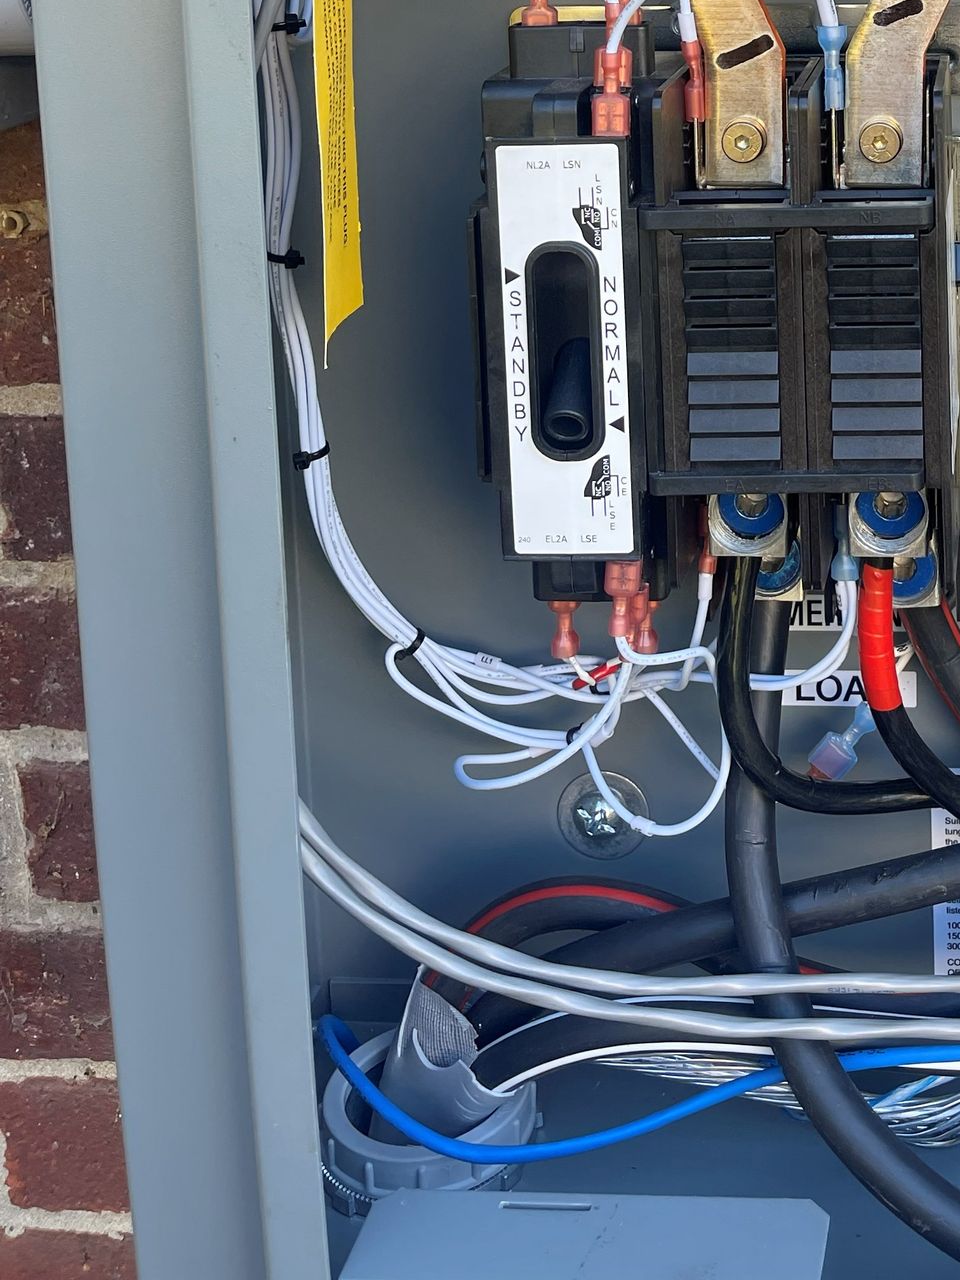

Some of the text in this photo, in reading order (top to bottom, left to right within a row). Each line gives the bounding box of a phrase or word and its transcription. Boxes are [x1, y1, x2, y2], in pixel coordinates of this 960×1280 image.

[526, 160, 581, 170] NL2A LSN
[603, 276, 621, 407] NORMAL
[509, 291, 528, 442] STANDBY
[545, 535, 568, 544] EL2A
[580, 535, 598, 543] LSE
[795, 674, 868, 702] LOA
